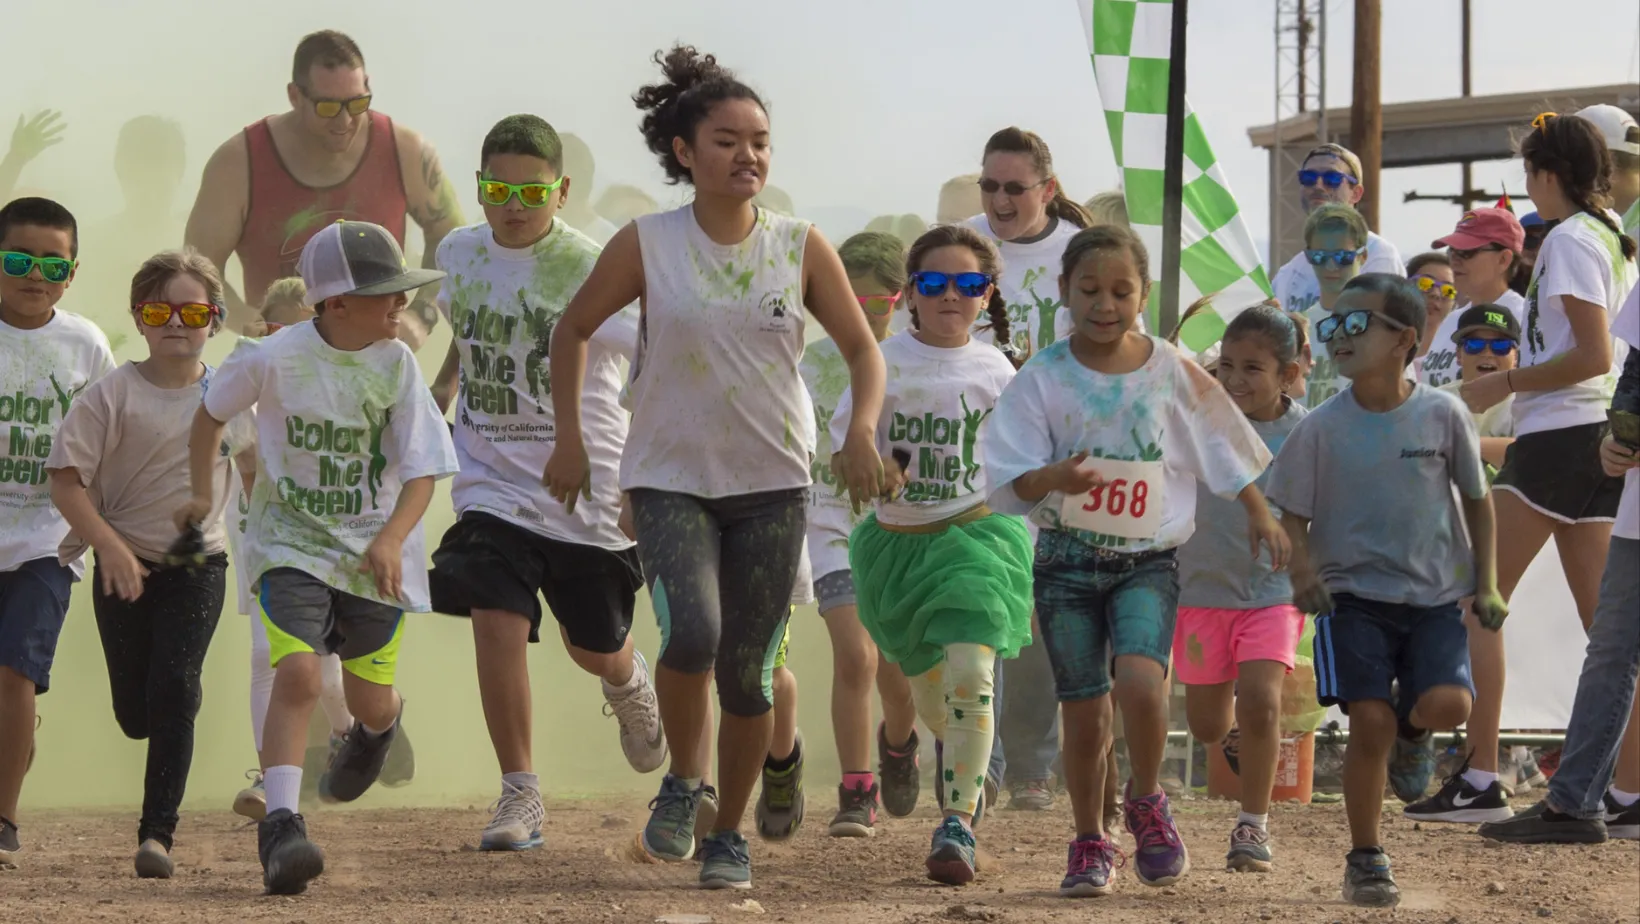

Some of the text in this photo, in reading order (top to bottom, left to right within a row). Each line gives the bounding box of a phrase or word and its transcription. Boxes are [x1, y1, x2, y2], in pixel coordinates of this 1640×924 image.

[451, 299, 519, 344] Color
[471, 344, 515, 384] Me
[1421, 349, 1457, 371] olor
[0, 390, 54, 424] olor
[460, 368, 518, 415] een
[9, 425, 51, 457] Me
[286, 415, 365, 453] Color
[507, 434, 532, 442] Natural
[533, 435, 556, 443] Resou
[508, 423, 553, 432] California
[889, 411, 961, 446] Color
[0, 457, 49, 484] een
[319, 455, 363, 487] Me
[919, 447, 960, 482] Me
[277, 476, 362, 517] Green
[904, 481, 959, 502] een
[1082, 478, 1148, 518] 368
